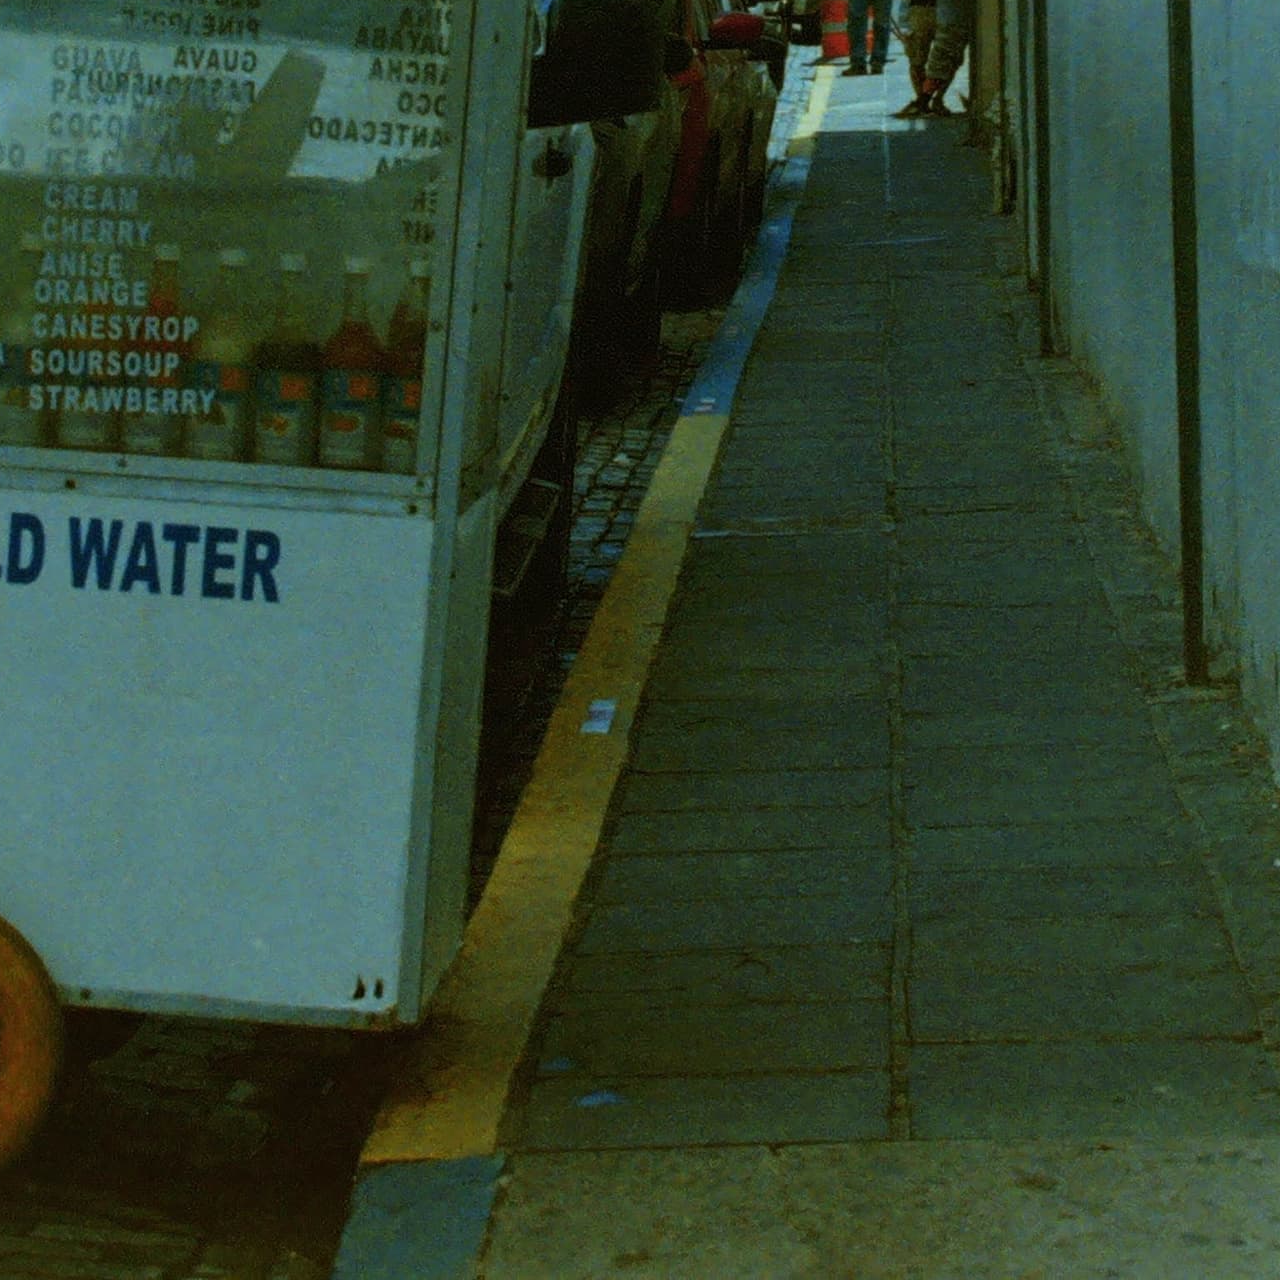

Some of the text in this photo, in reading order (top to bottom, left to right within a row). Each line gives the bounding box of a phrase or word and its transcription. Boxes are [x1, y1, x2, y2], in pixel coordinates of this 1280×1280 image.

[52, 44, 142, 71] GUAVA
[46, 182, 139, 212] CREAM
[42, 215, 153, 248] CHERRY
[39, 251, 124, 279] ANISE
[34, 278, 149, 308] ORANGE
[31, 312, 201, 343] CANESYROP
[30, 348, 180, 379] SOURSOUP
[28, 384, 217, 416] STRAWBERRY
[69, 517, 282, 603] WATER
